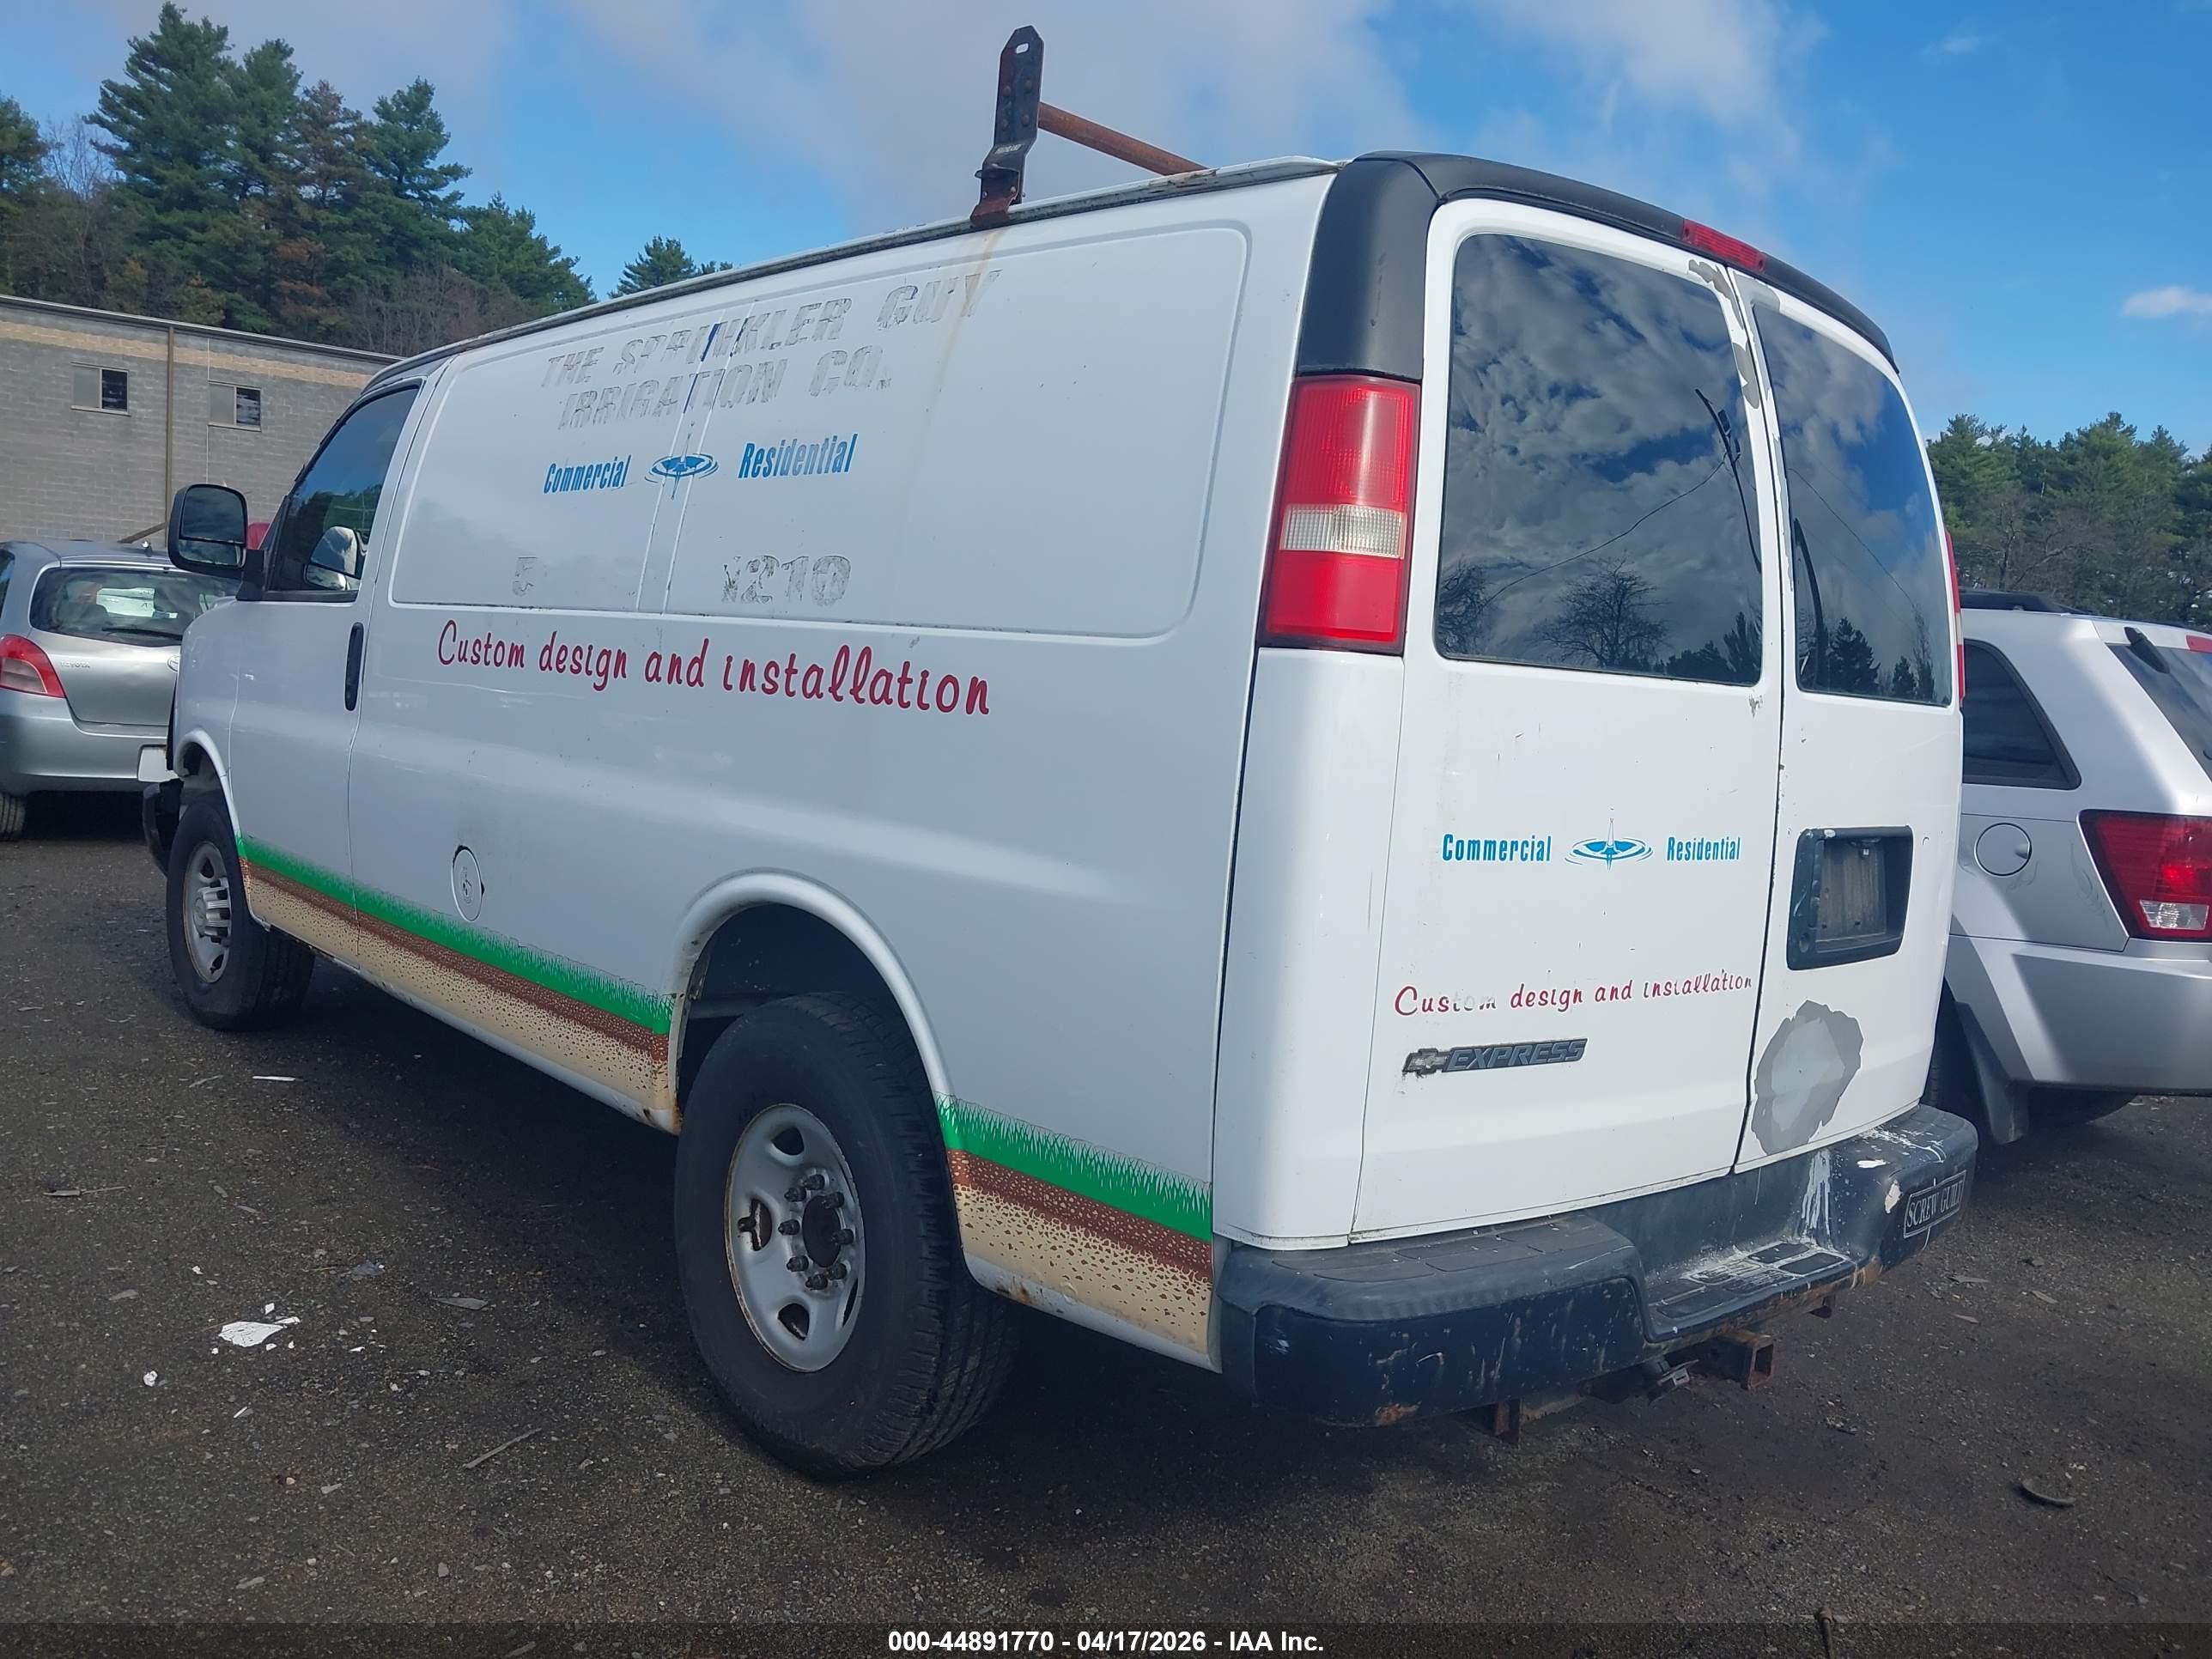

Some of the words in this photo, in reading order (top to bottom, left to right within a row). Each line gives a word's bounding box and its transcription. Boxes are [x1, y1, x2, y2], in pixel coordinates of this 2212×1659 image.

[541, 346, 604, 387] THE
[558, 357, 787, 429] IRRIGATION
[543, 455, 632, 495] Commercial
[738, 433, 858, 480] Residential
[438, 619, 526, 669] Custom
[538, 631, 628, 690] design
[644, 638, 710, 689] and
[721, 645, 990, 715] installation
[1442, 833, 1552, 861] Commercial
[1666, 836, 1741, 861] Residential
[1510, 983, 1583, 1013] design
[1595, 980, 1632, 1003] and
[1446, 1039, 1587, 1072] EXPRESS
